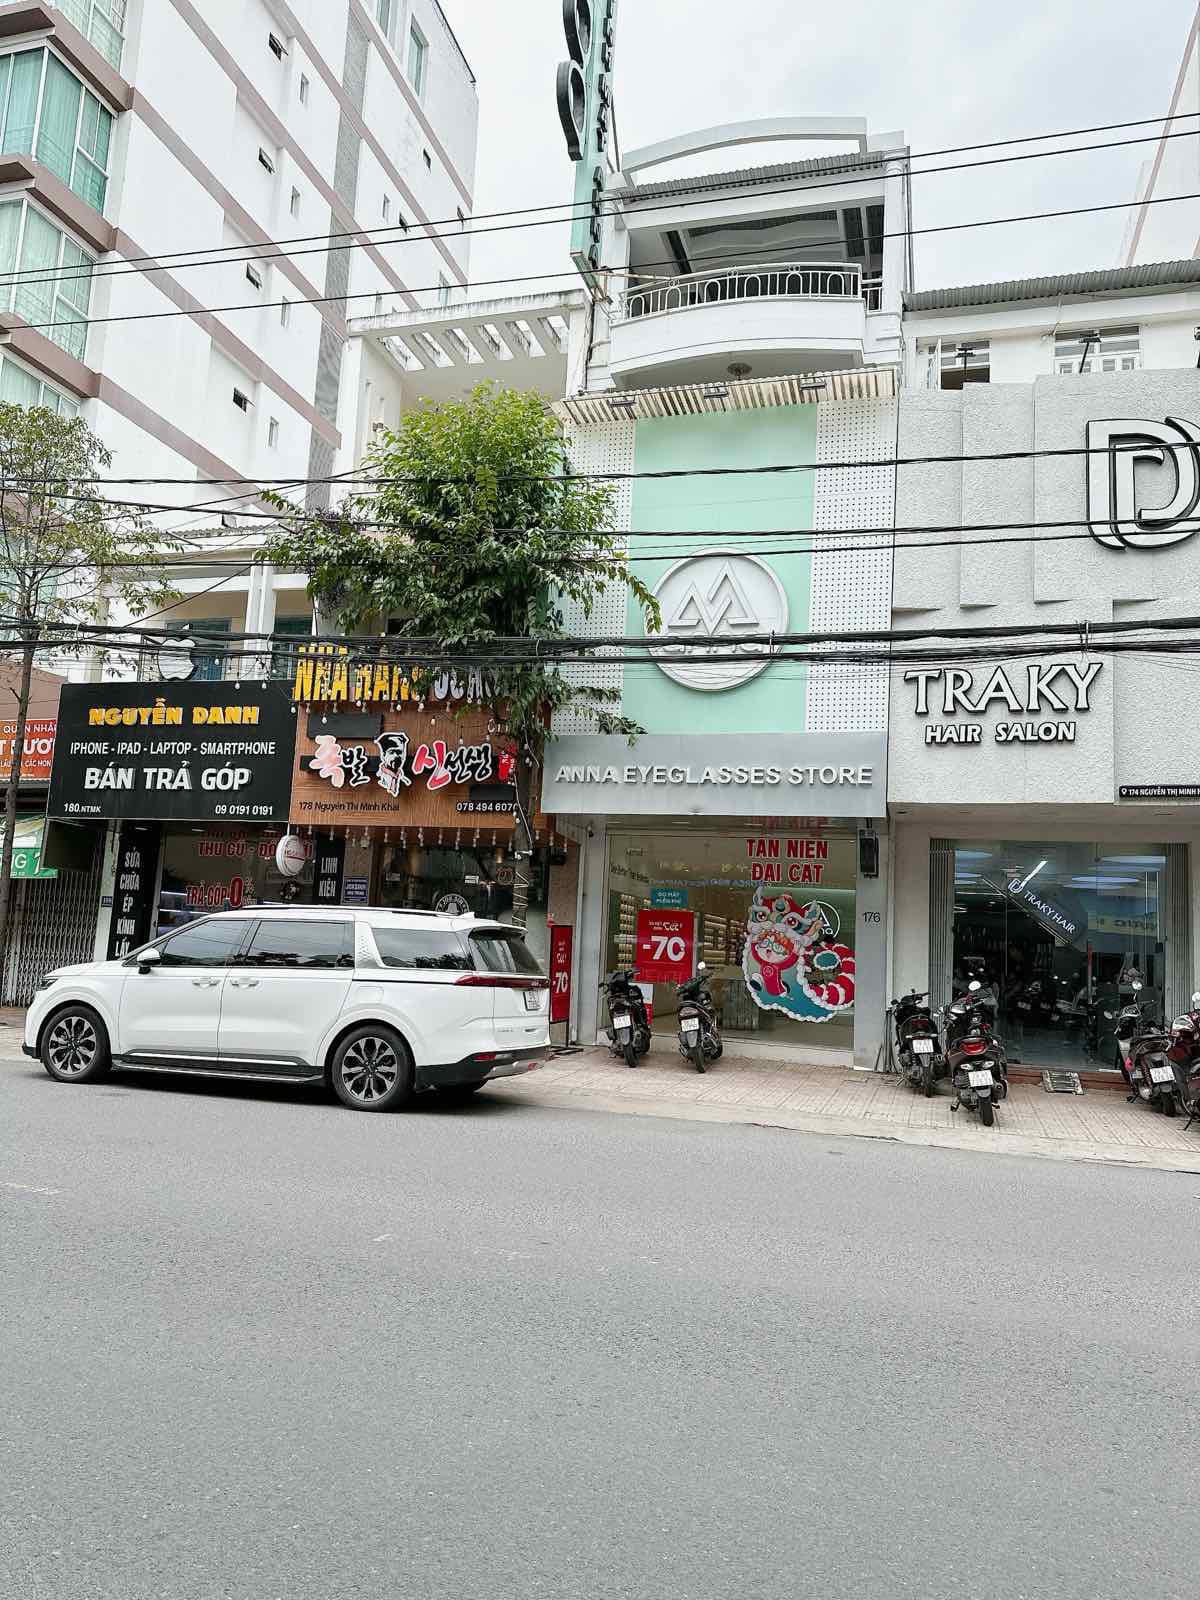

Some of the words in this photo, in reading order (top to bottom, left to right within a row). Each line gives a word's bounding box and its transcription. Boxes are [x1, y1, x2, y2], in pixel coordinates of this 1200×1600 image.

[904, 663, 1104, 714] TRAKY
[88, 697, 183, 726] NGUYỄN
[192, 706, 260, 725] DANH
[3, 725, 31, 734] QUN
[925, 724, 981, 744] HAIR
[995, 722, 1076, 742] SALON
[70, 742, 109, 755] IPHONE
[117, 742, 141, 755] IPAD
[150, 742, 192, 755] LAPTOP
[200, 742, 276, 755] SMARTPHONE
[412, 740, 493, 790] 신선생
[555, 765, 619, 784] ANNA
[623, 766, 781, 785] EYEGLASSES
[787, 766, 873, 785] STORE
[84, 762, 135, 790] BÁN
[143, 761, 192, 790] TRẢ
[200, 762, 251, 790] GÓP
[215, 805, 227, 815] 09
[229, 806, 250, 815] 0191
[252, 806, 273, 816] 0191
[360, 802, 380, 810] Minh
[456, 803, 474, 812] 078
[476, 803, 494, 812] 494
[863, 912, 881, 922] 176
[1024, 890, 1054, 917] TRAKY
[1052, 914, 1075, 934] HAIR
